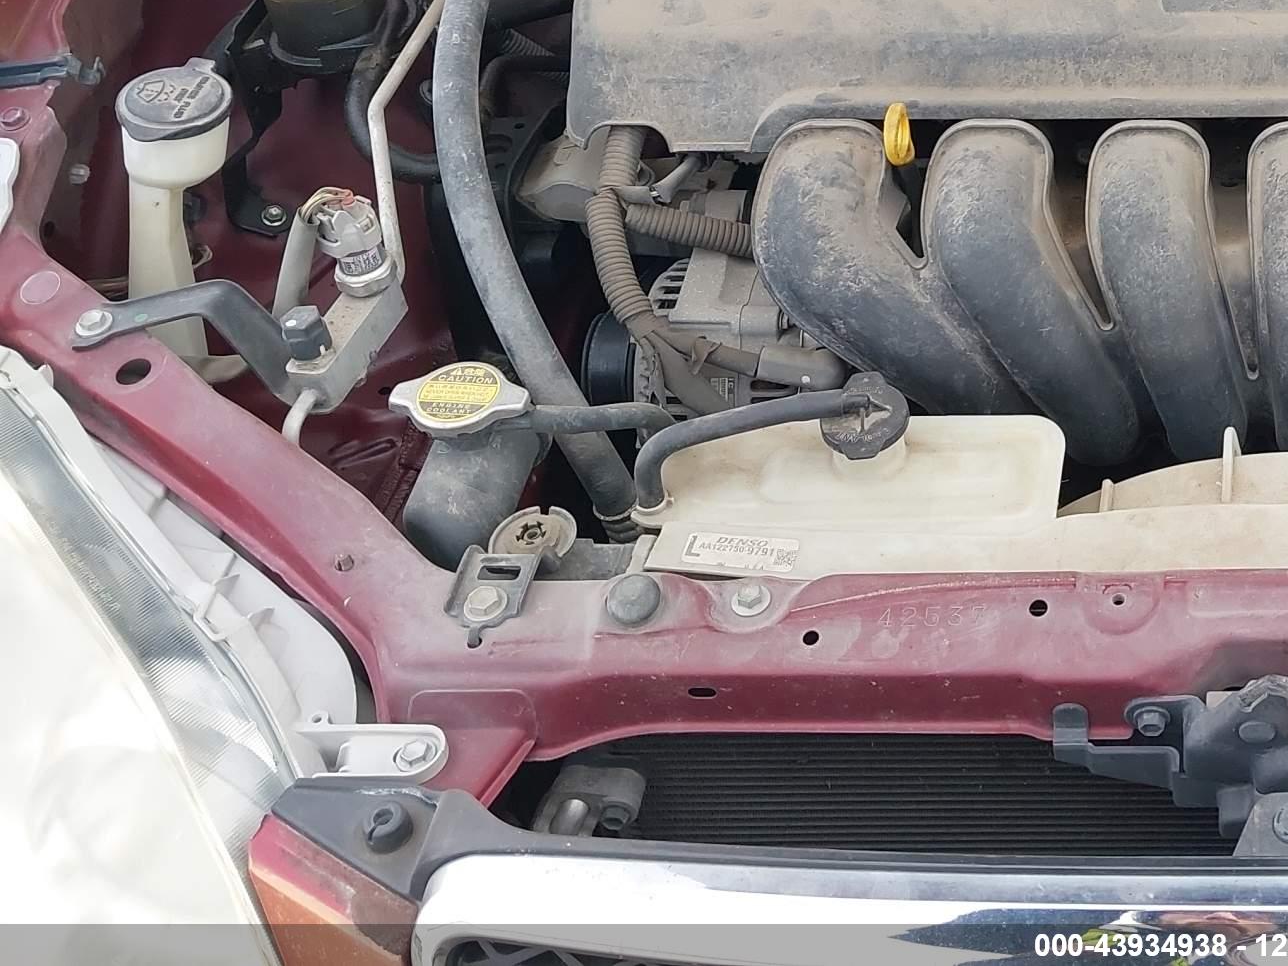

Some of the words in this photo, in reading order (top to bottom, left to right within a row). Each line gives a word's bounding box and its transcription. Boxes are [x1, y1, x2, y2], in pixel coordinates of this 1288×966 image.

[438, 374, 494, 384] CAUTION
[426, 407, 472, 415] COOLANT
[685, 535, 701, 557] L
[717, 537, 769, 547] DENSO
[879, 604, 986, 627] 42537
